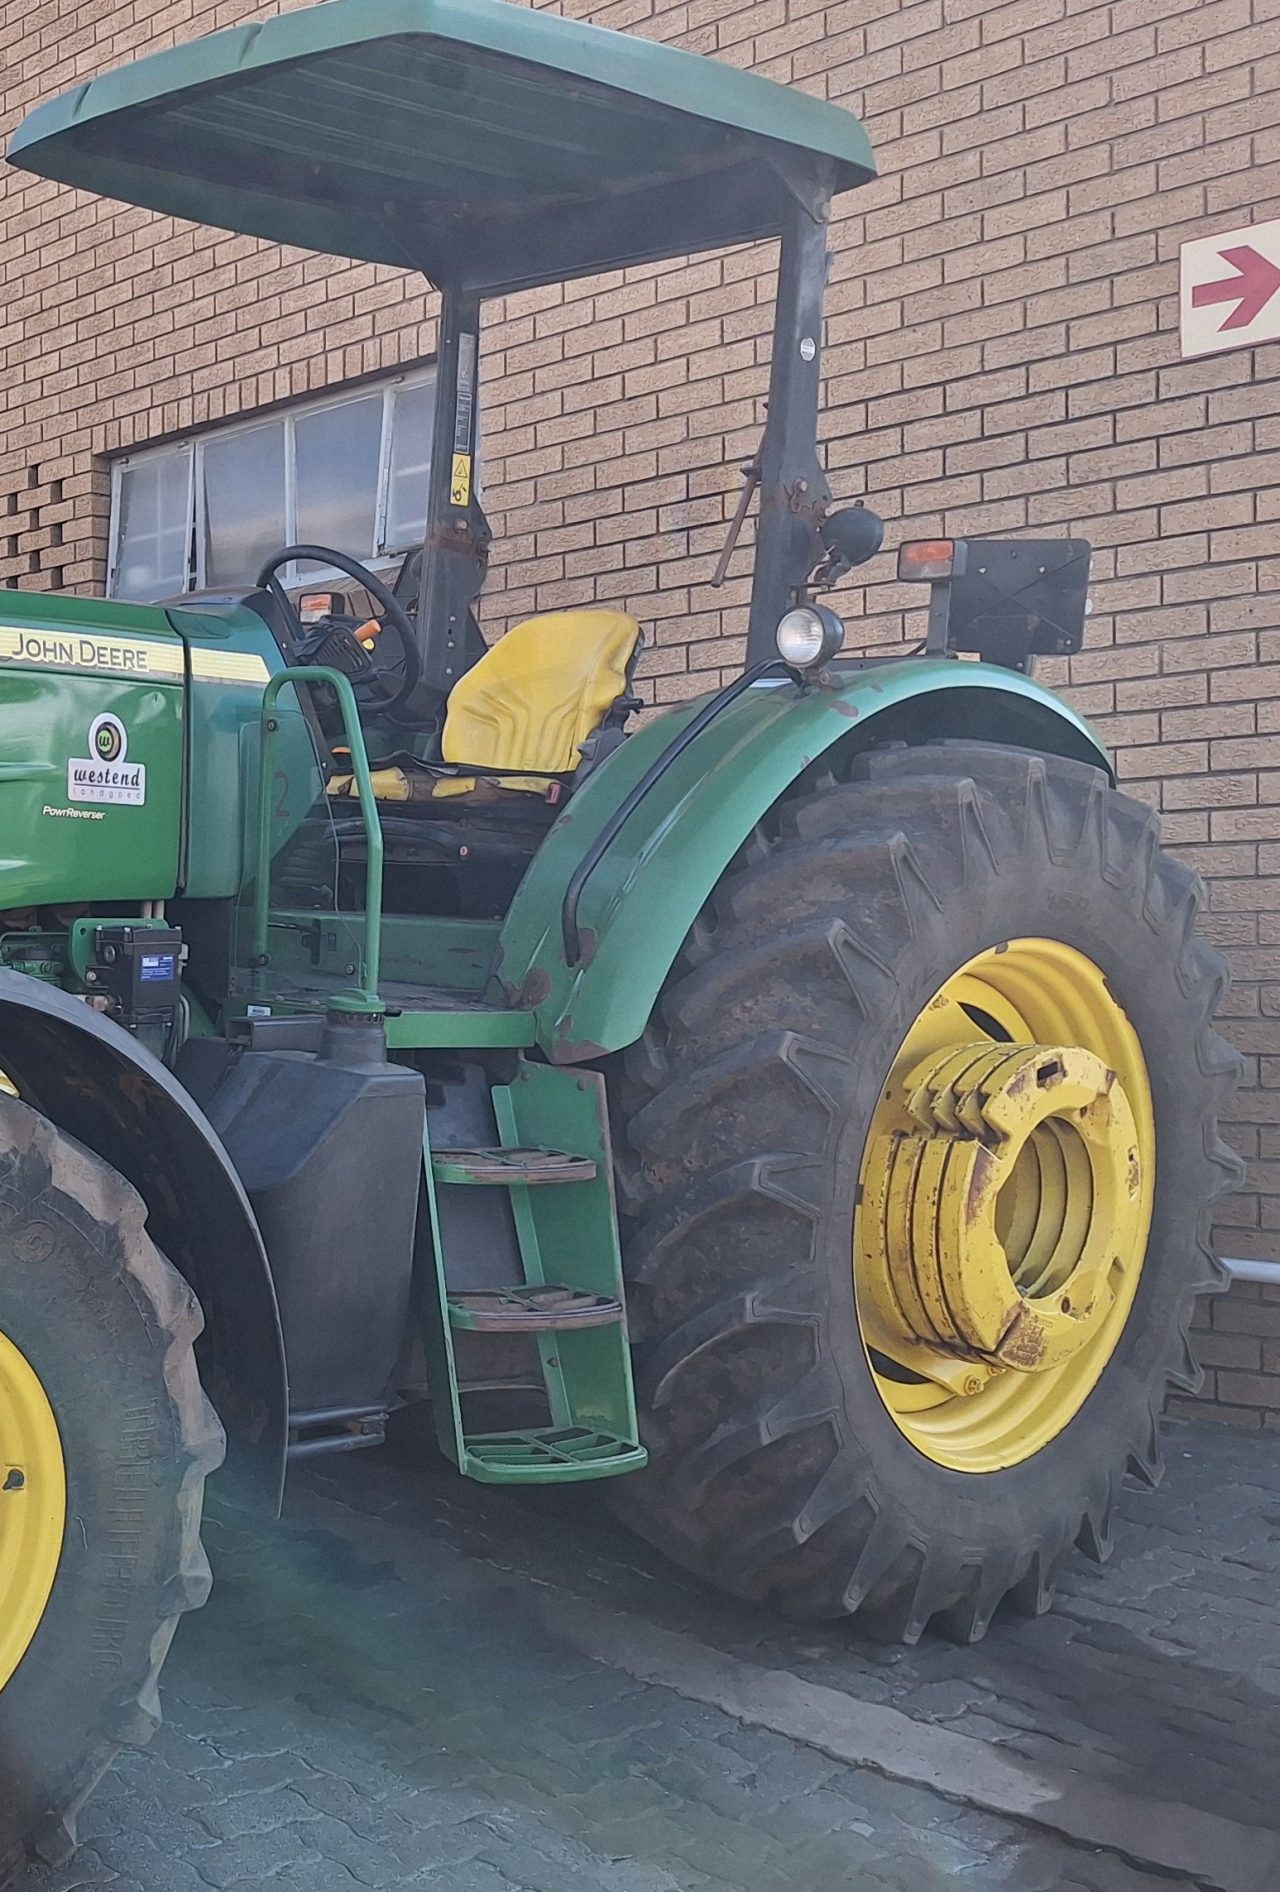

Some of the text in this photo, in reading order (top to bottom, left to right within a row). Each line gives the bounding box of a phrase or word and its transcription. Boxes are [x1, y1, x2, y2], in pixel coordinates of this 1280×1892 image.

[12, 633, 148, 669] JOHN DEERE
[73, 768, 140, 786] westend
[42, 805, 106, 820] PowrReverser
